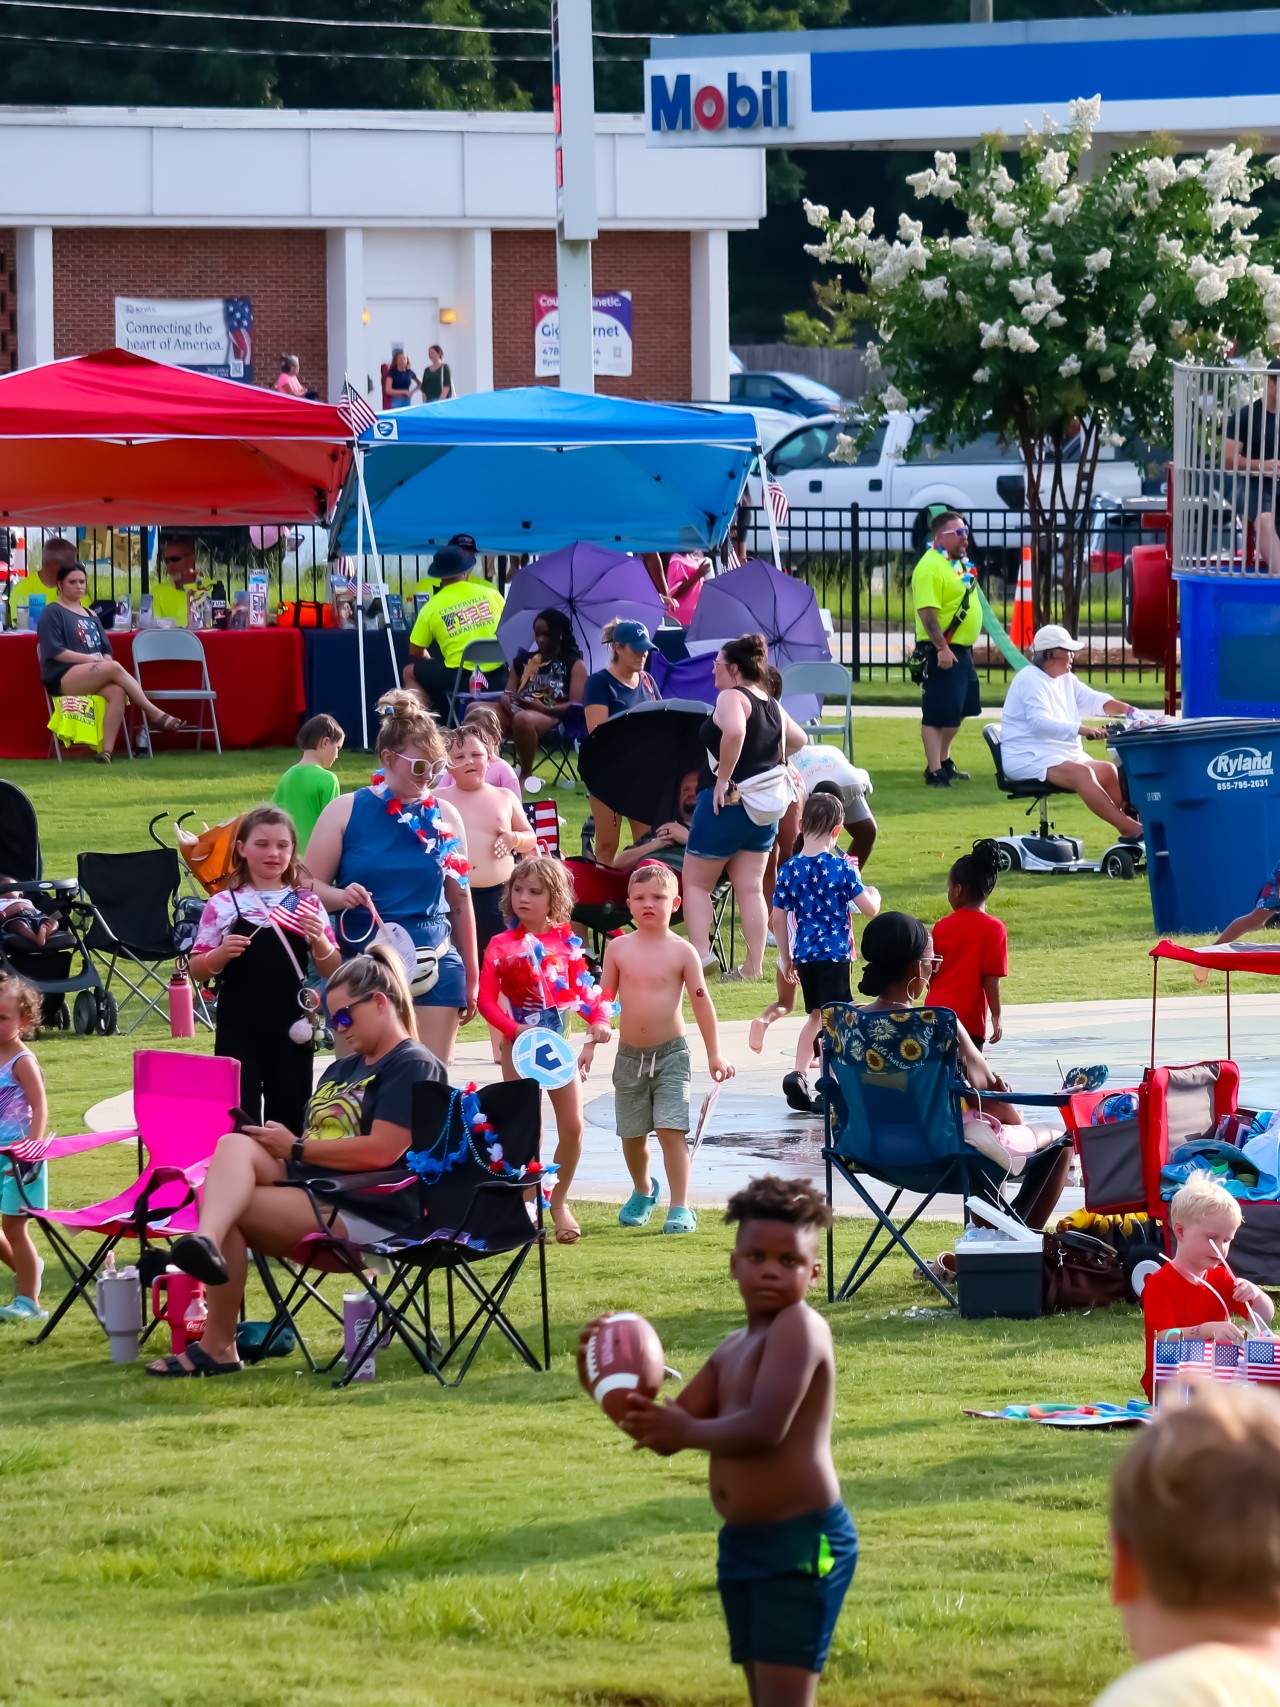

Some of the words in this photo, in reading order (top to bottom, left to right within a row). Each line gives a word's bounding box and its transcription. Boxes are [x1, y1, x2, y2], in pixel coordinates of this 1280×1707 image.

[650, 70, 788, 132] Mobil
[592, 295, 622, 307] inetic.
[125, 321, 192, 336] Connecting
[195, 321, 213, 334] the
[126, 338, 156, 351] heart
[159, 337, 172, 350] of
[173, 338, 224, 351] America.
[438, 594, 488, 616] CENTERVILLE
[441, 600, 494, 633] FIRE
[449, 618, 496, 638] DEPARTMENT
[1217, 751, 1273, 777] Ryland
[1216, 779, 1269, 791] 855-795-2631
